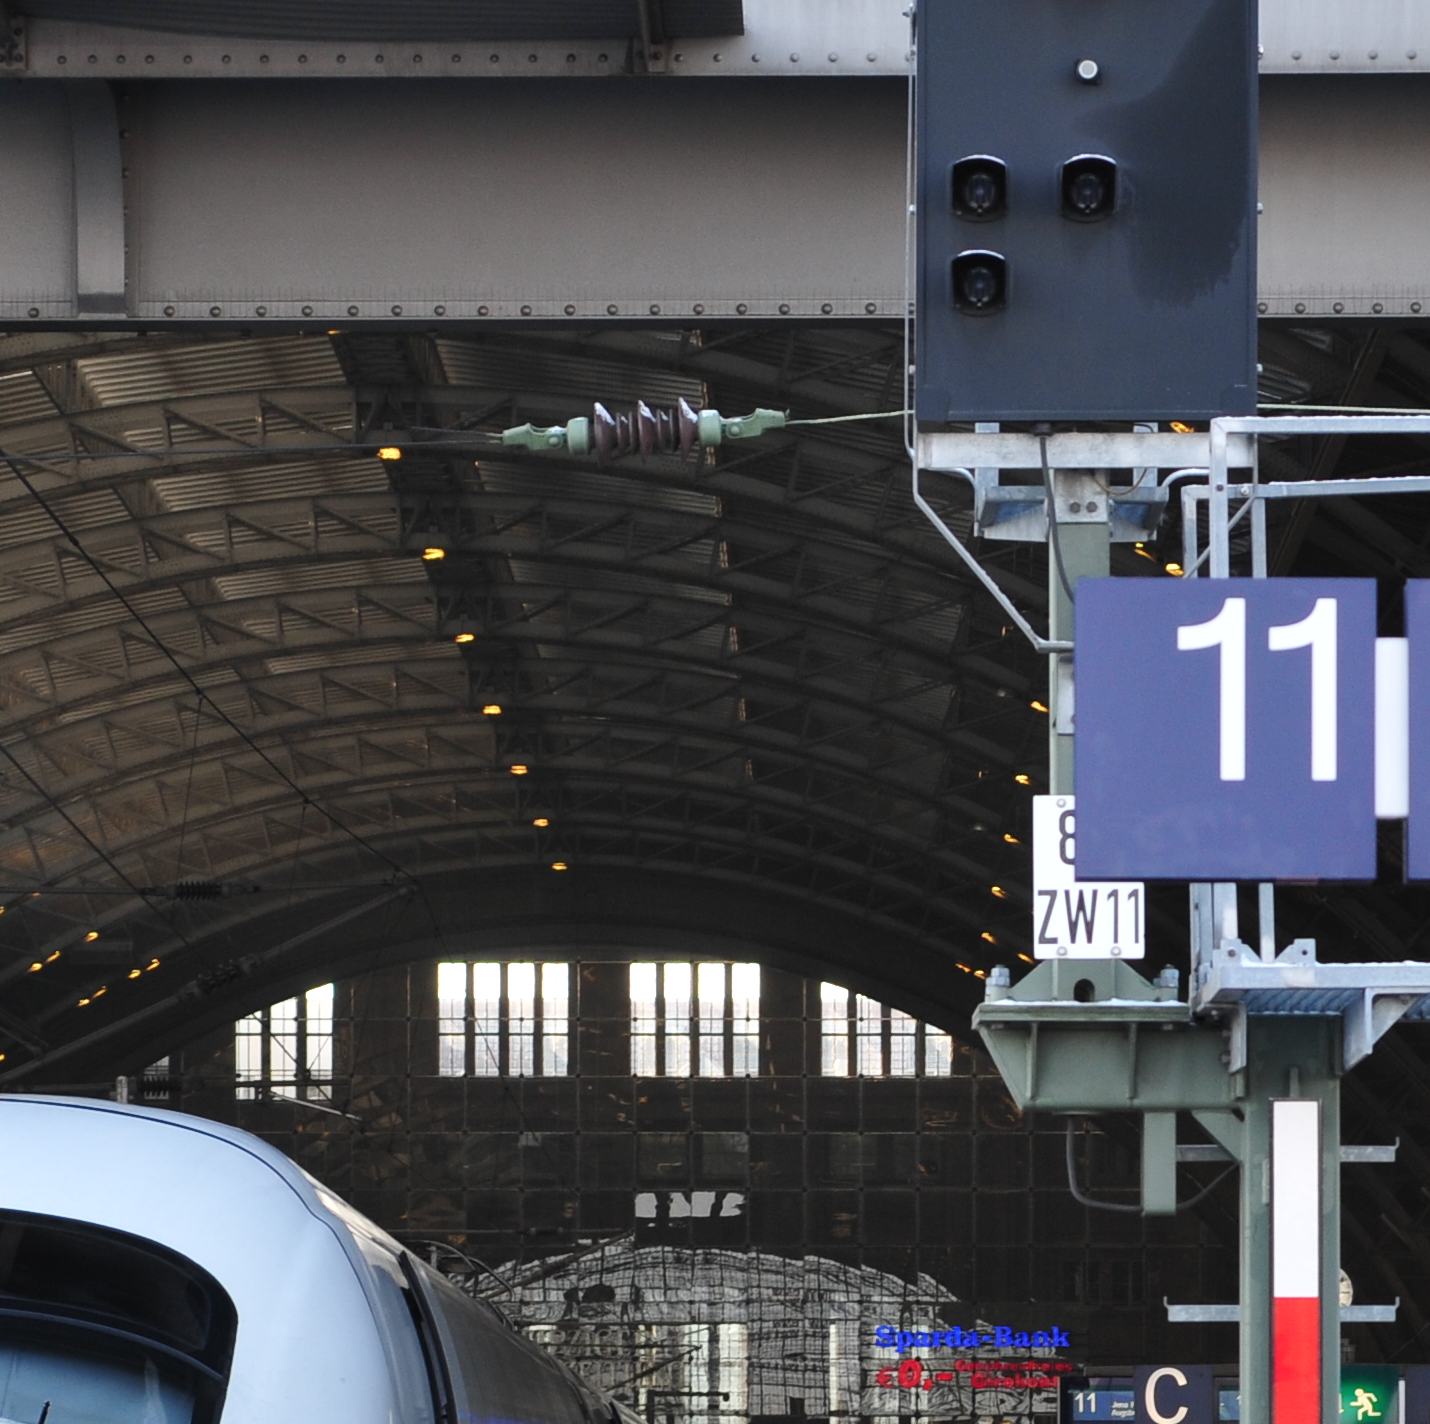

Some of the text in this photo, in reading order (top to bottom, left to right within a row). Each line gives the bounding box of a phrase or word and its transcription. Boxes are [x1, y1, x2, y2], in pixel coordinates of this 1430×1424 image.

[1177, 598, 1337, 781] 11
[1037, 888, 1140, 945] ZW11
[875, 1325, 1071, 1354] Sparda-Bank
[1074, 1392, 1096, 1413] 11
